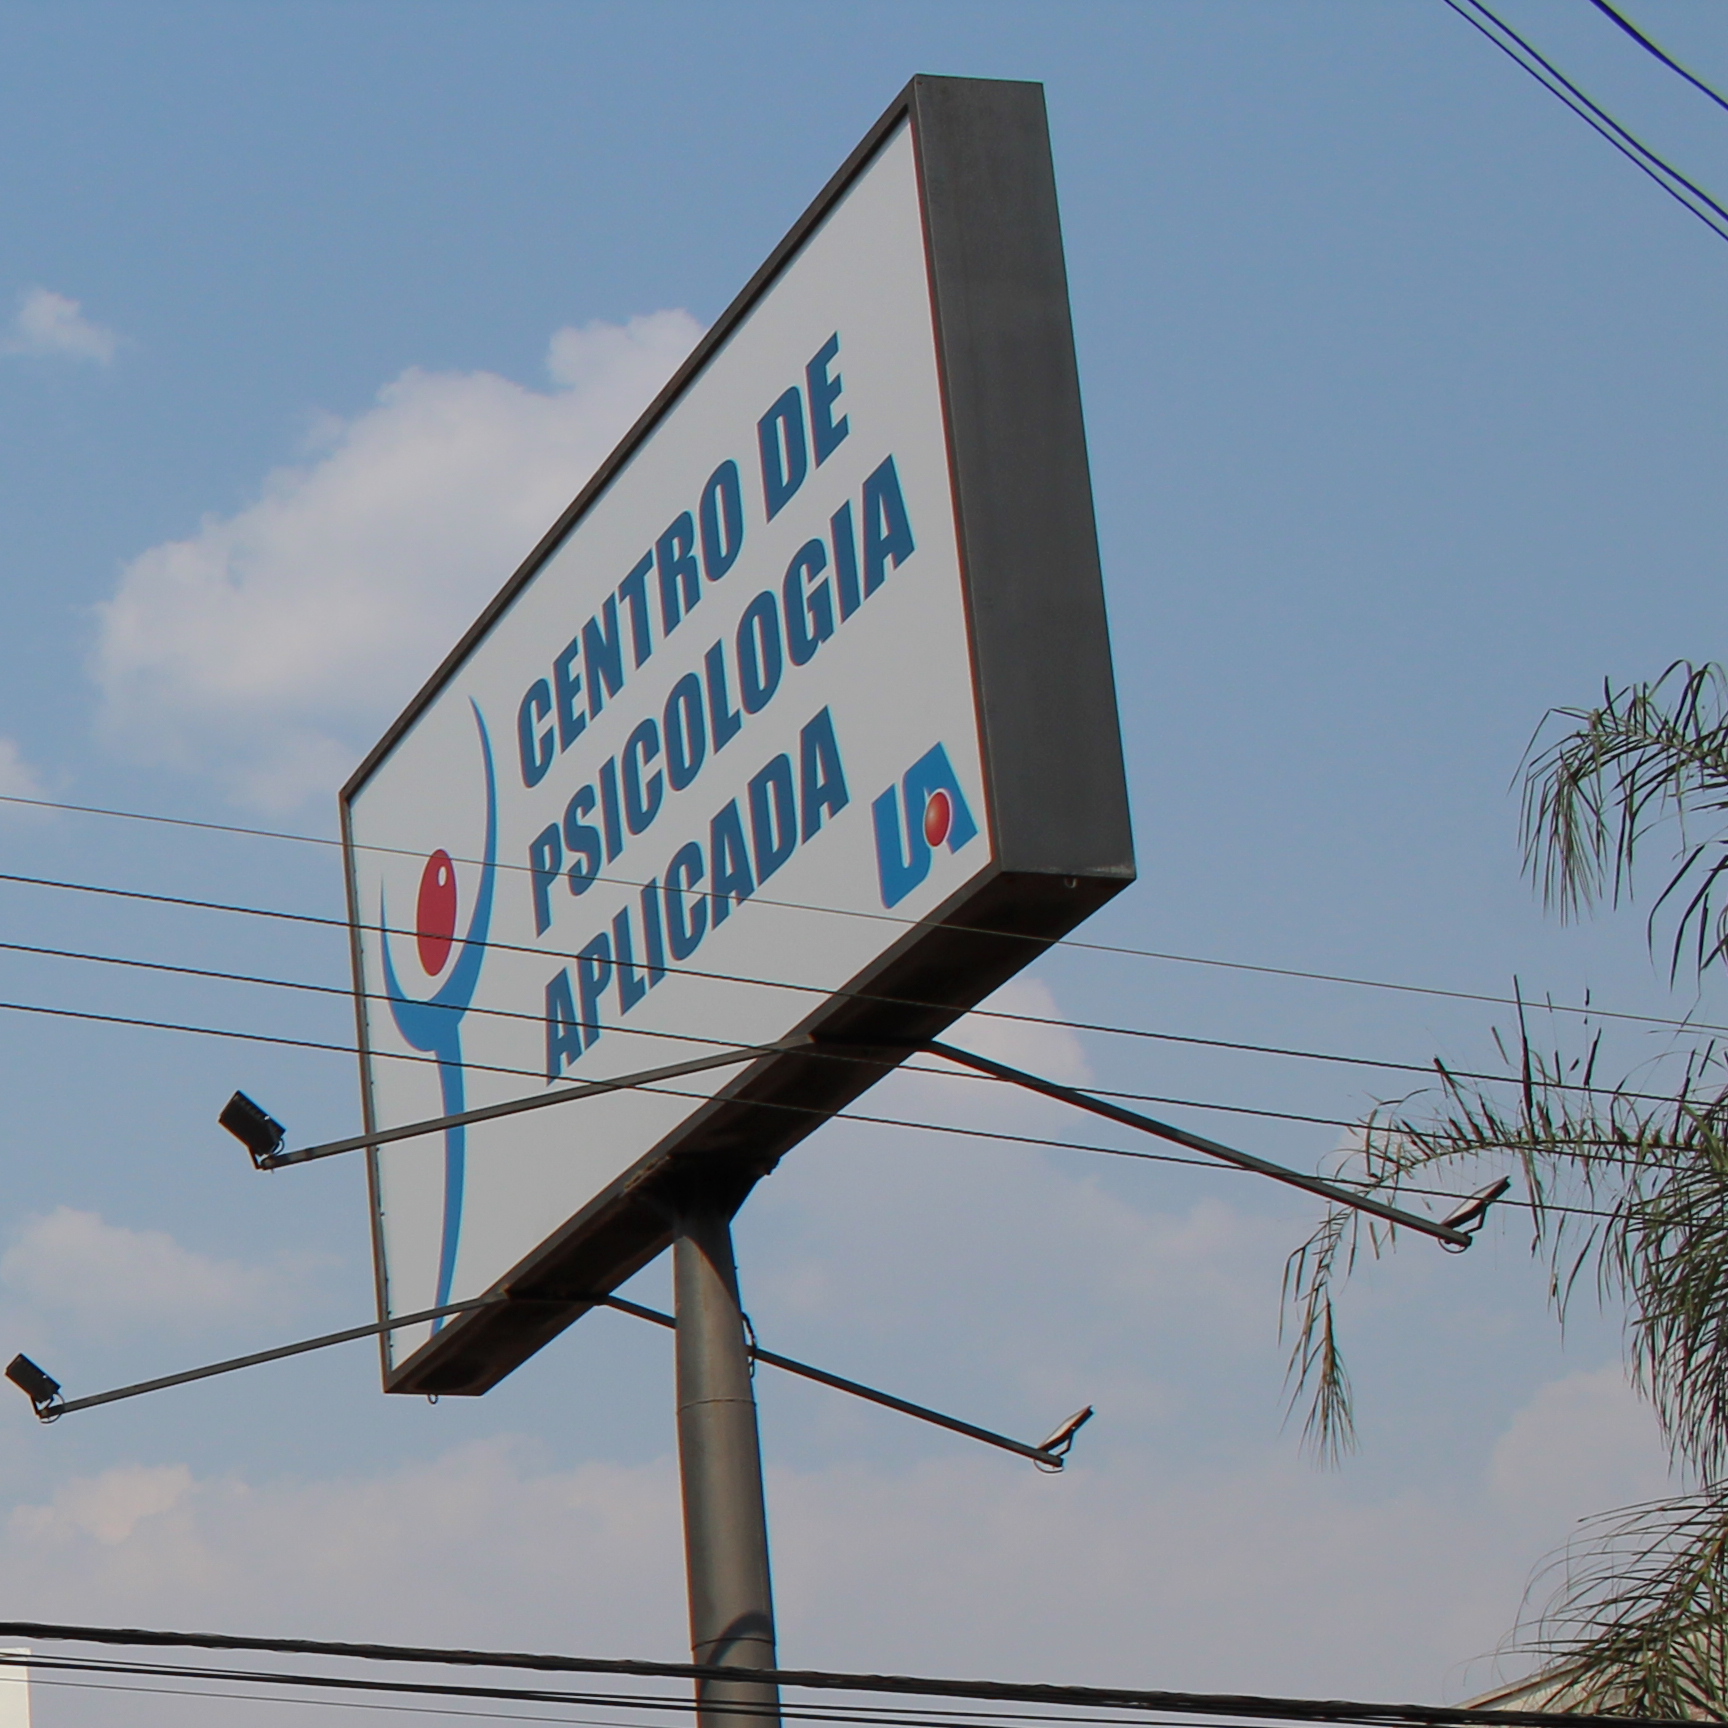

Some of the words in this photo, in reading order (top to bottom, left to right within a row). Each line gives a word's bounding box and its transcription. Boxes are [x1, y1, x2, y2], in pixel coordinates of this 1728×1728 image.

[515, 458, 745, 791] CENTRO
[757, 330, 851, 525] DE
[526, 452, 916, 938] PSICOLOGIA
[543, 703, 851, 1086] APLICADA
